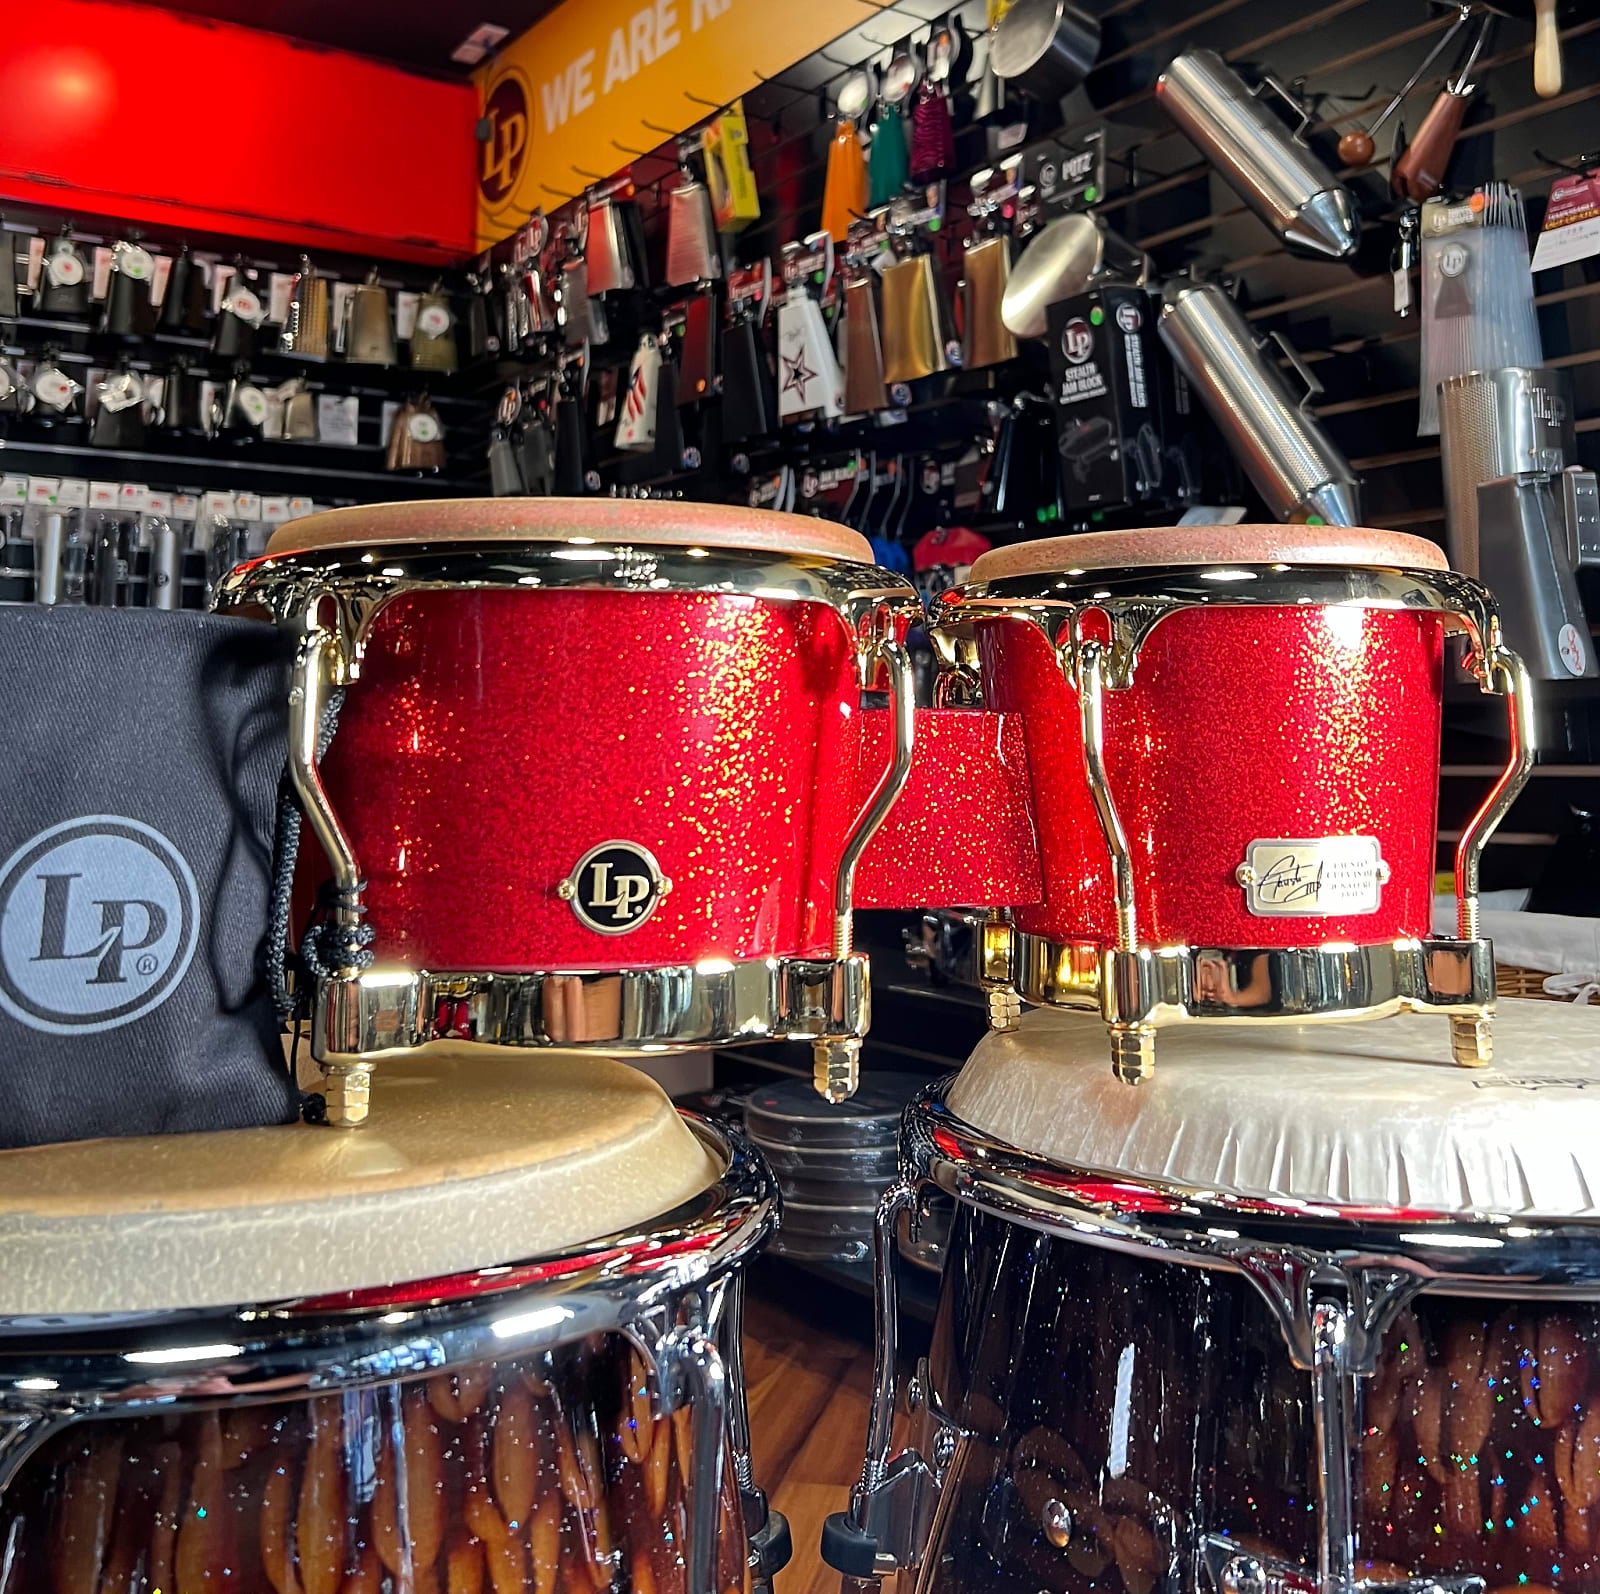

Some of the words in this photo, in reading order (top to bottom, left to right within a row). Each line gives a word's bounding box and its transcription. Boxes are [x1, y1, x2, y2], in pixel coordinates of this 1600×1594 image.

[541, 49, 596, 135] WE
[602, 0, 681, 95] ARE
[482, 107, 526, 192] LP
[1065, 328, 1090, 358] LP
[1065, 362, 1097, 382] STEALTH
[588, 862, 650, 919] LP
[28, 872, 169, 985] LP
